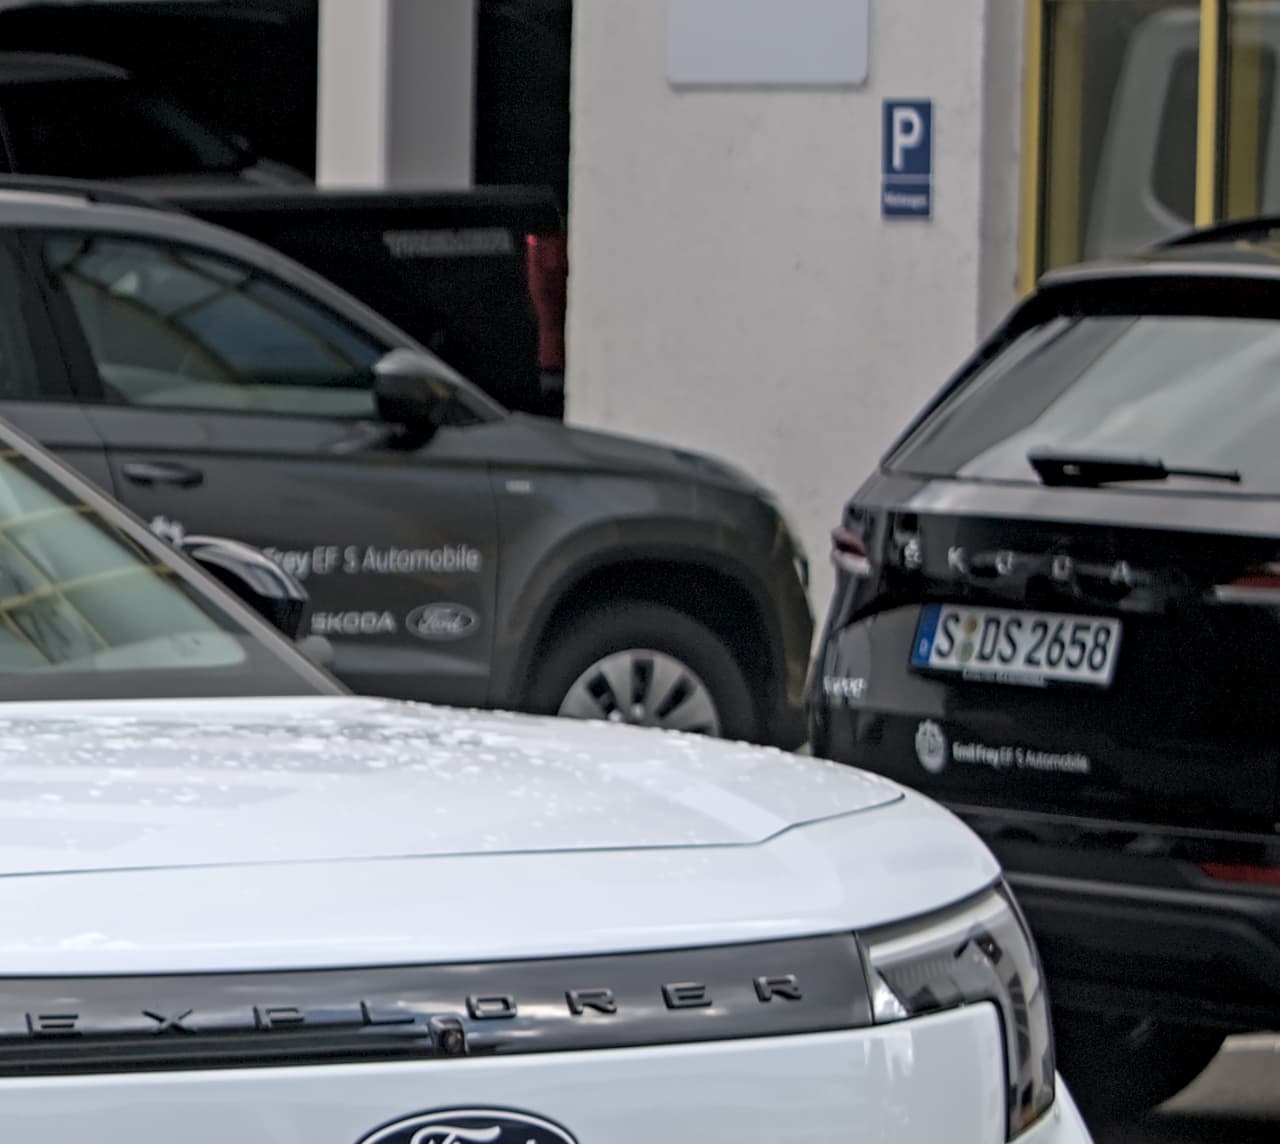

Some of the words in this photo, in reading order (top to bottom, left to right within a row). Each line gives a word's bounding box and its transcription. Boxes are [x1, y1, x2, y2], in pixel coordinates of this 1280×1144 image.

[892, 105, 924, 171] P
[362, 543, 482, 574] Automobile
[935, 613, 960, 657] S
[976, 615, 1022, 663] DS
[1024, 618, 1111, 671] 2658
[25, 974, 802, 1038] EXPLORER
